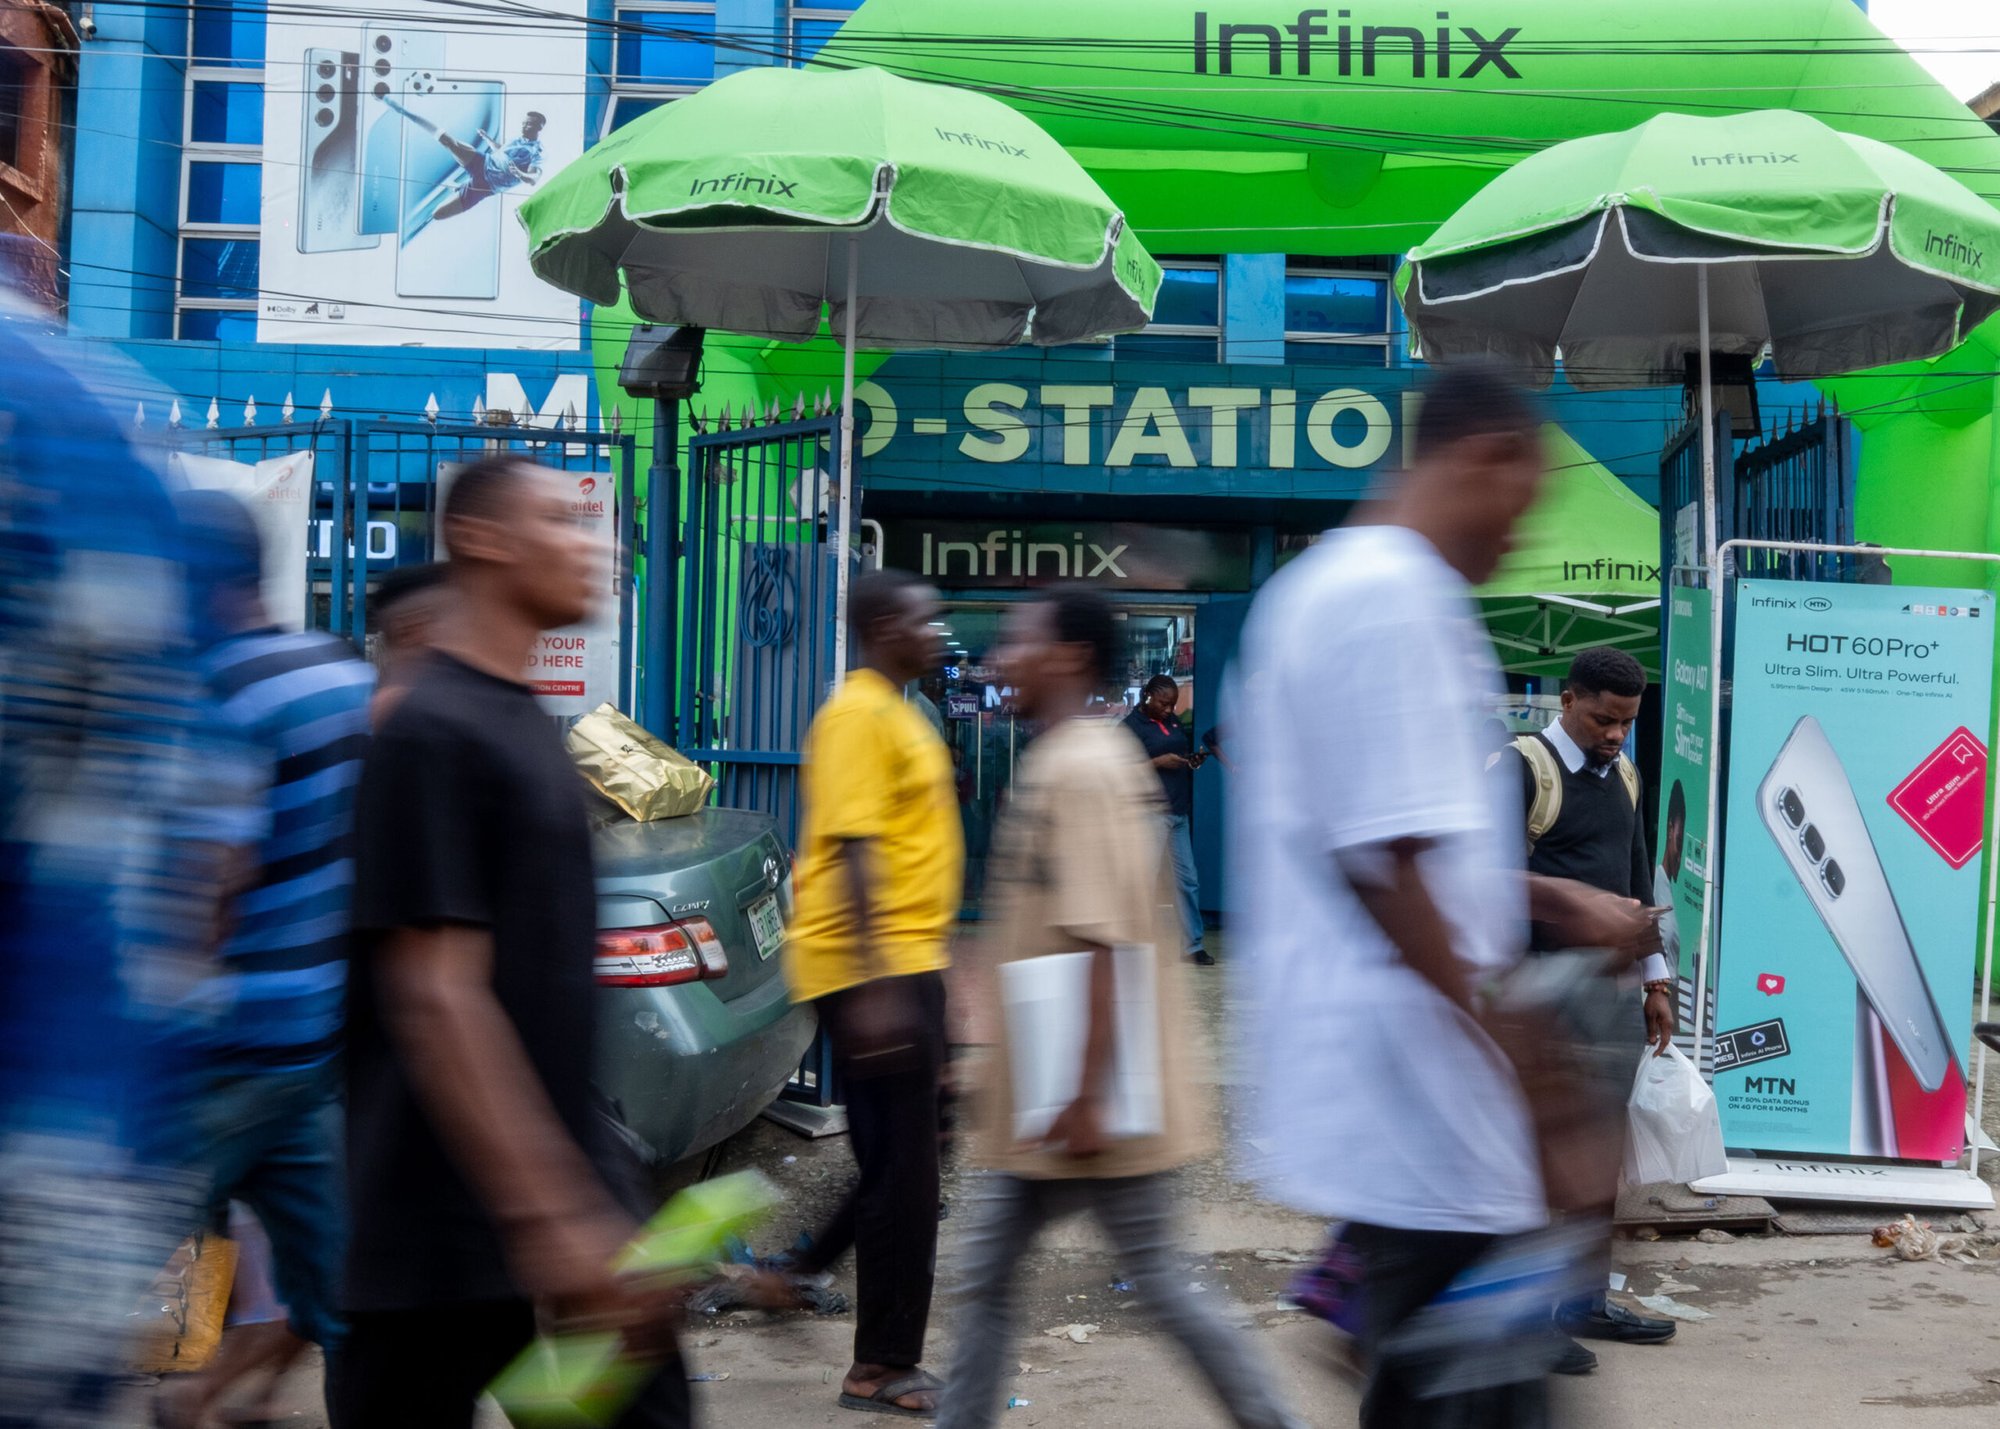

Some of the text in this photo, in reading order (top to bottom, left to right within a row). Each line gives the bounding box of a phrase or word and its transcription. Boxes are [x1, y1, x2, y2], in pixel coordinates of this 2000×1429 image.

[1194, 9, 1524, 79] Infinix
[935, 128, 1031, 160] Infinix
[1691, 152, 1799, 166] Infinix
[689, 172, 799, 199] Infinix
[1924, 229, 1984, 269] Infinix
[276, 306, 296, 314] Dolby
[267, 487, 303, 500] airtel
[571, 500, 604, 512] airtel
[923, 530, 1129, 578] Infinix
[1564, 558, 1661, 582] Infinix
[1752, 597, 1797, 609] Infinix
[543, 637, 585, 650] YOUR
[544, 655, 583, 668] HERE
[1674, 658, 1696, 694] Galaxy
[1765, 663, 1960, 685] Ultra Slim. Ultra Powerful.
[961, 702, 977, 713] PULL
[1926, 775, 1961, 805] Ultra Slim
[1765, 1044, 1782, 1053] Phone
[1745, 1076, 1796, 1096] MTN
[1745, 1096, 1761, 1104] 50%
[1774, 1163, 1889, 1177] Infinix
